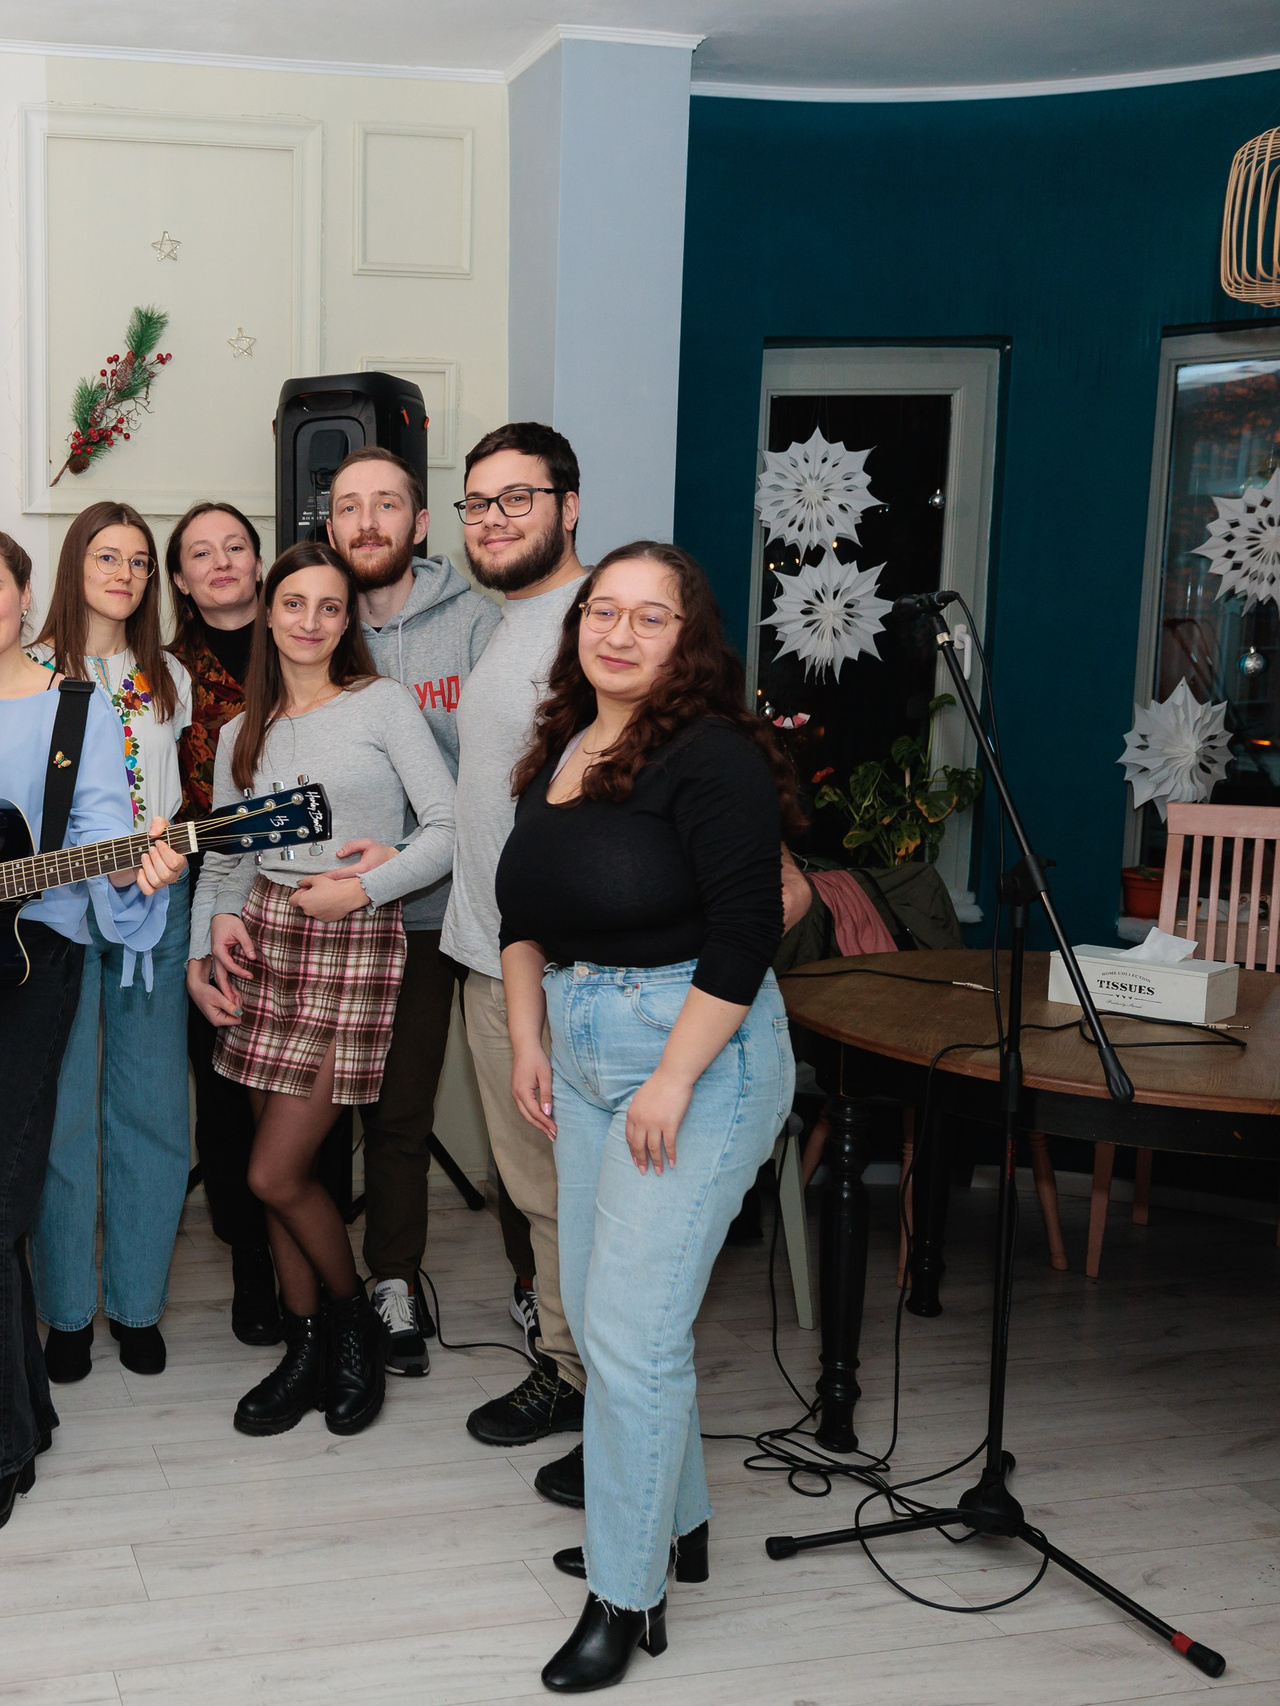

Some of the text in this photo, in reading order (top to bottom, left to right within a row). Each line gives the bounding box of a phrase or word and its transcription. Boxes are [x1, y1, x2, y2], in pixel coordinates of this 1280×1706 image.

[407, 675, 461, 713] УНД
[1117, 971, 1151, 983] COLLECTION
[1096, 979, 1155, 996] TISSUES
